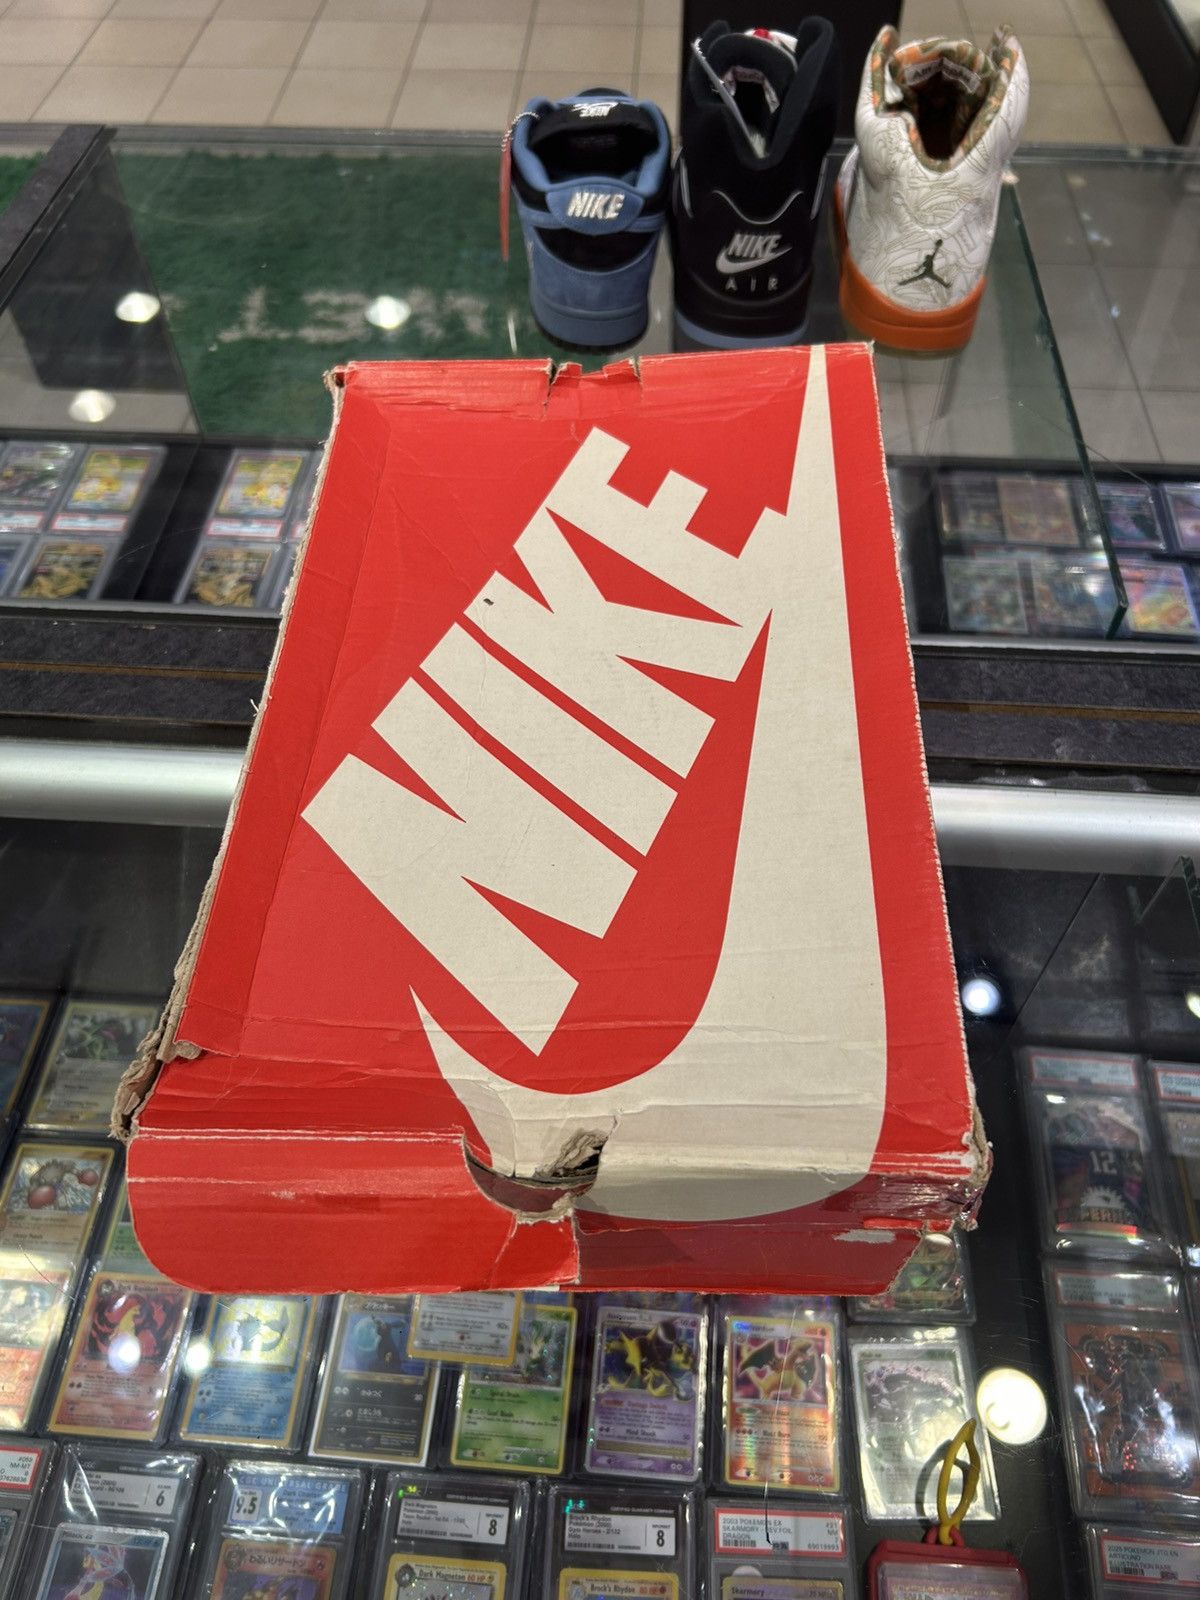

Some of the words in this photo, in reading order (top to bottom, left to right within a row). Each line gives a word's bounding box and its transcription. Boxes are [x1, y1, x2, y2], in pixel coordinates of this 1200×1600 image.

[567, 191, 625, 219] NIKE
[727, 232, 783, 258] NIKE
[725, 276, 778, 292] AIR
[300, 426, 788, 1057] NIKE
[155, 1490, 165, 1506] 6
[235, 1496, 258, 1515] 9.5
[488, 1519, 497, 1536] 8
[722, 1532, 751, 1540] DRAGON
[656, 1530, 665, 1547] 8
